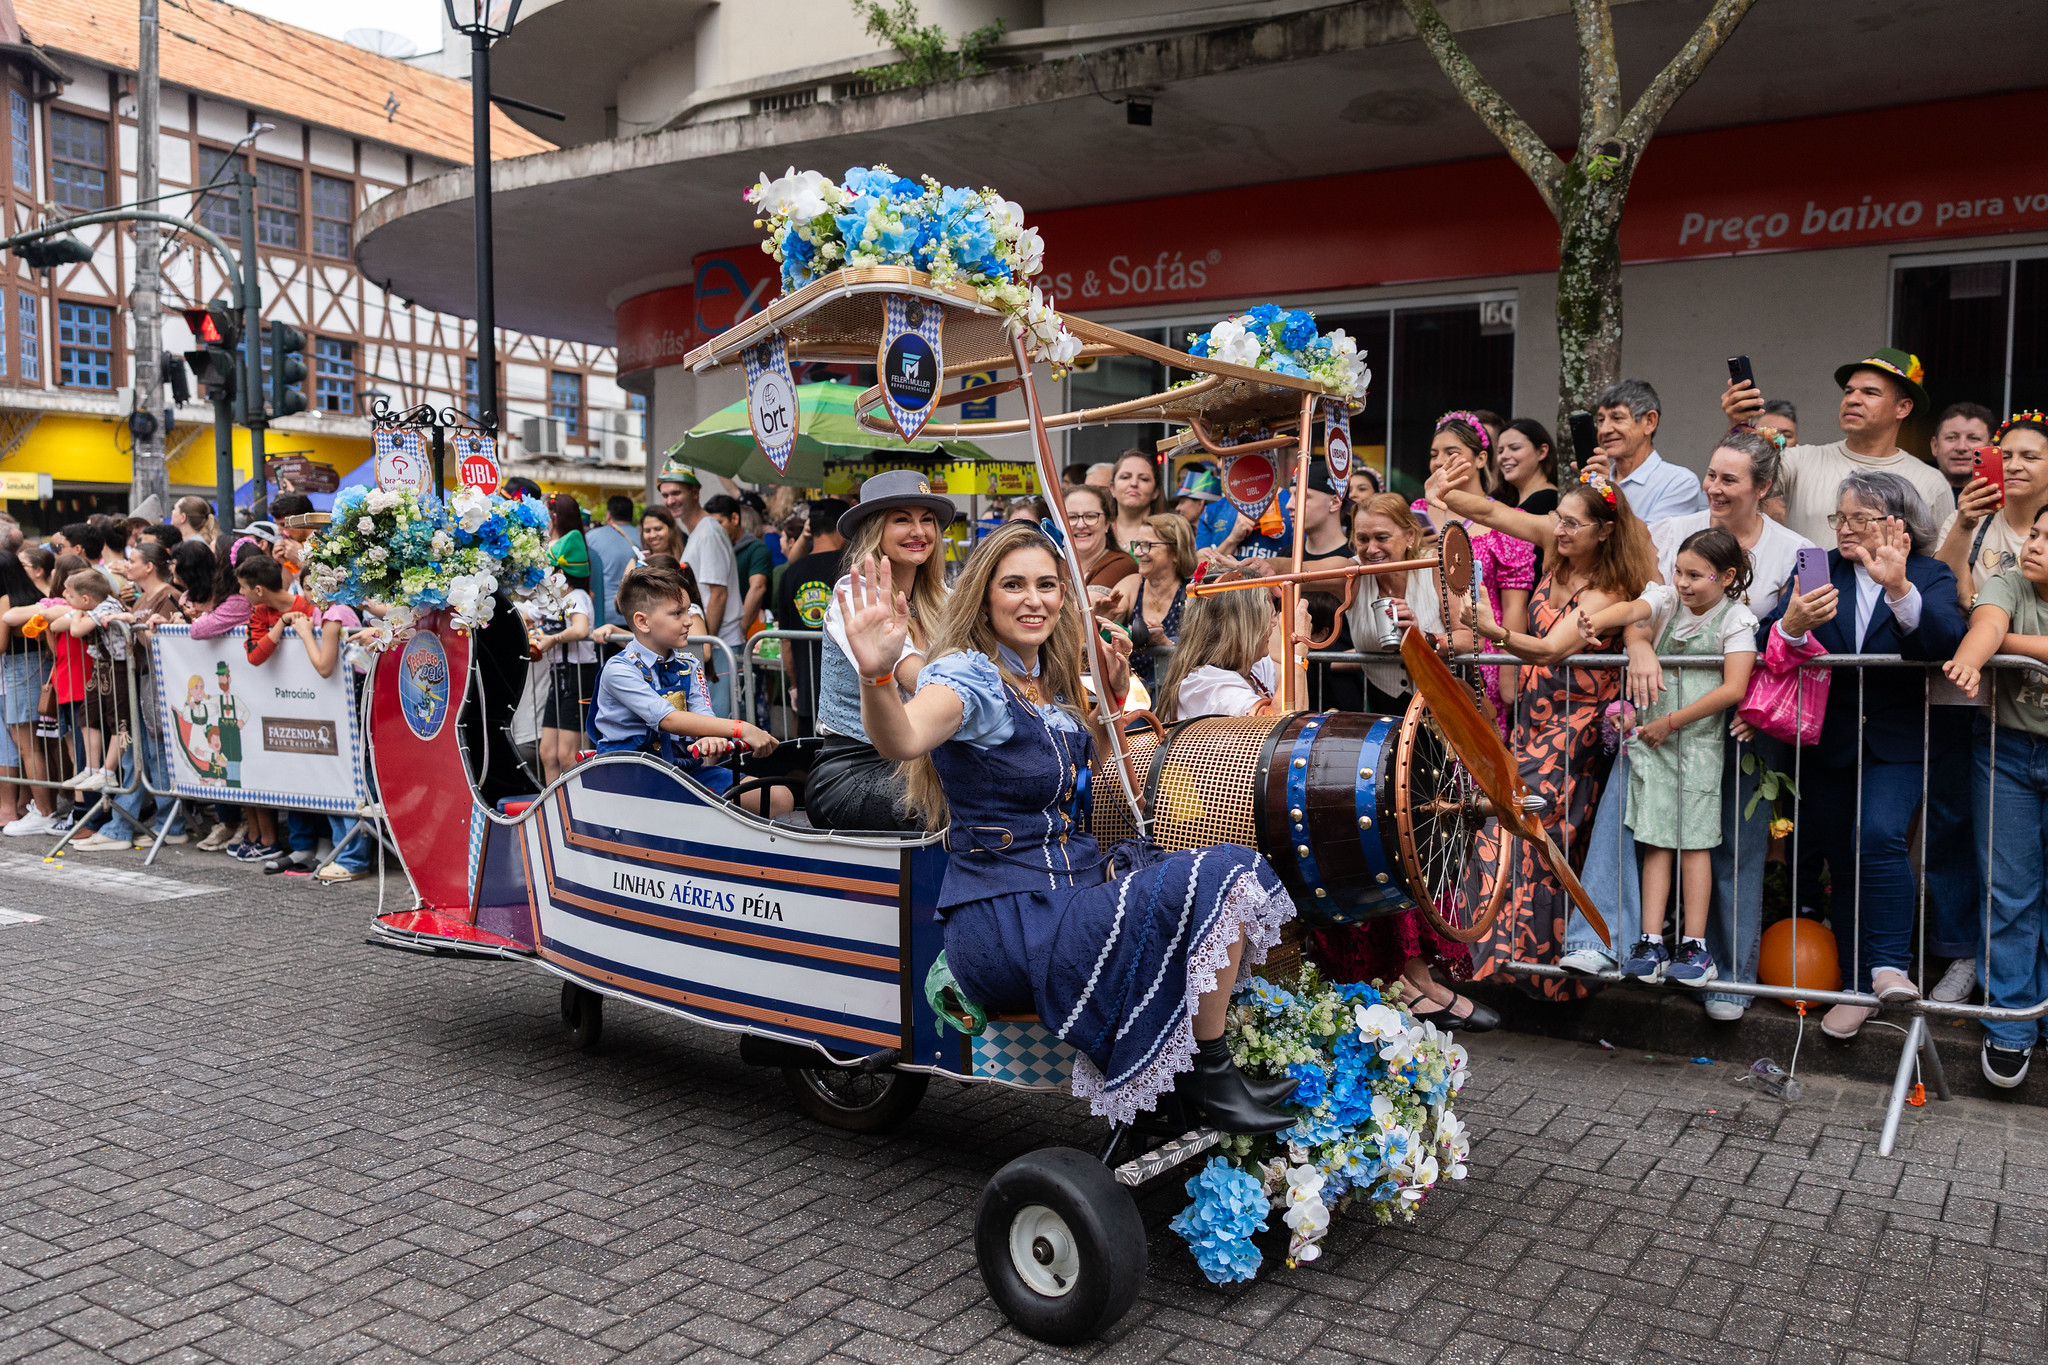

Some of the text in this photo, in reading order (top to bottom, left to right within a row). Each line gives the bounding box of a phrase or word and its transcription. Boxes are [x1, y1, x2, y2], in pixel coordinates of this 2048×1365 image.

[1679, 213, 1790, 249] Preço
[1801, 196, 1923, 236] baixo
[1936, 198, 2004, 227] para
[1081, 270, 1101, 298] &
[760, 404, 788, 434] brt
[464, 463, 496, 485] JBL
[275, 687, 316, 700] Patrocínio
[268, 726, 317, 740] FAZZENDA
[269, 738, 318, 749] Park Resort
[612, 871, 784, 922] LINHAS AÉREAS PÉIA
